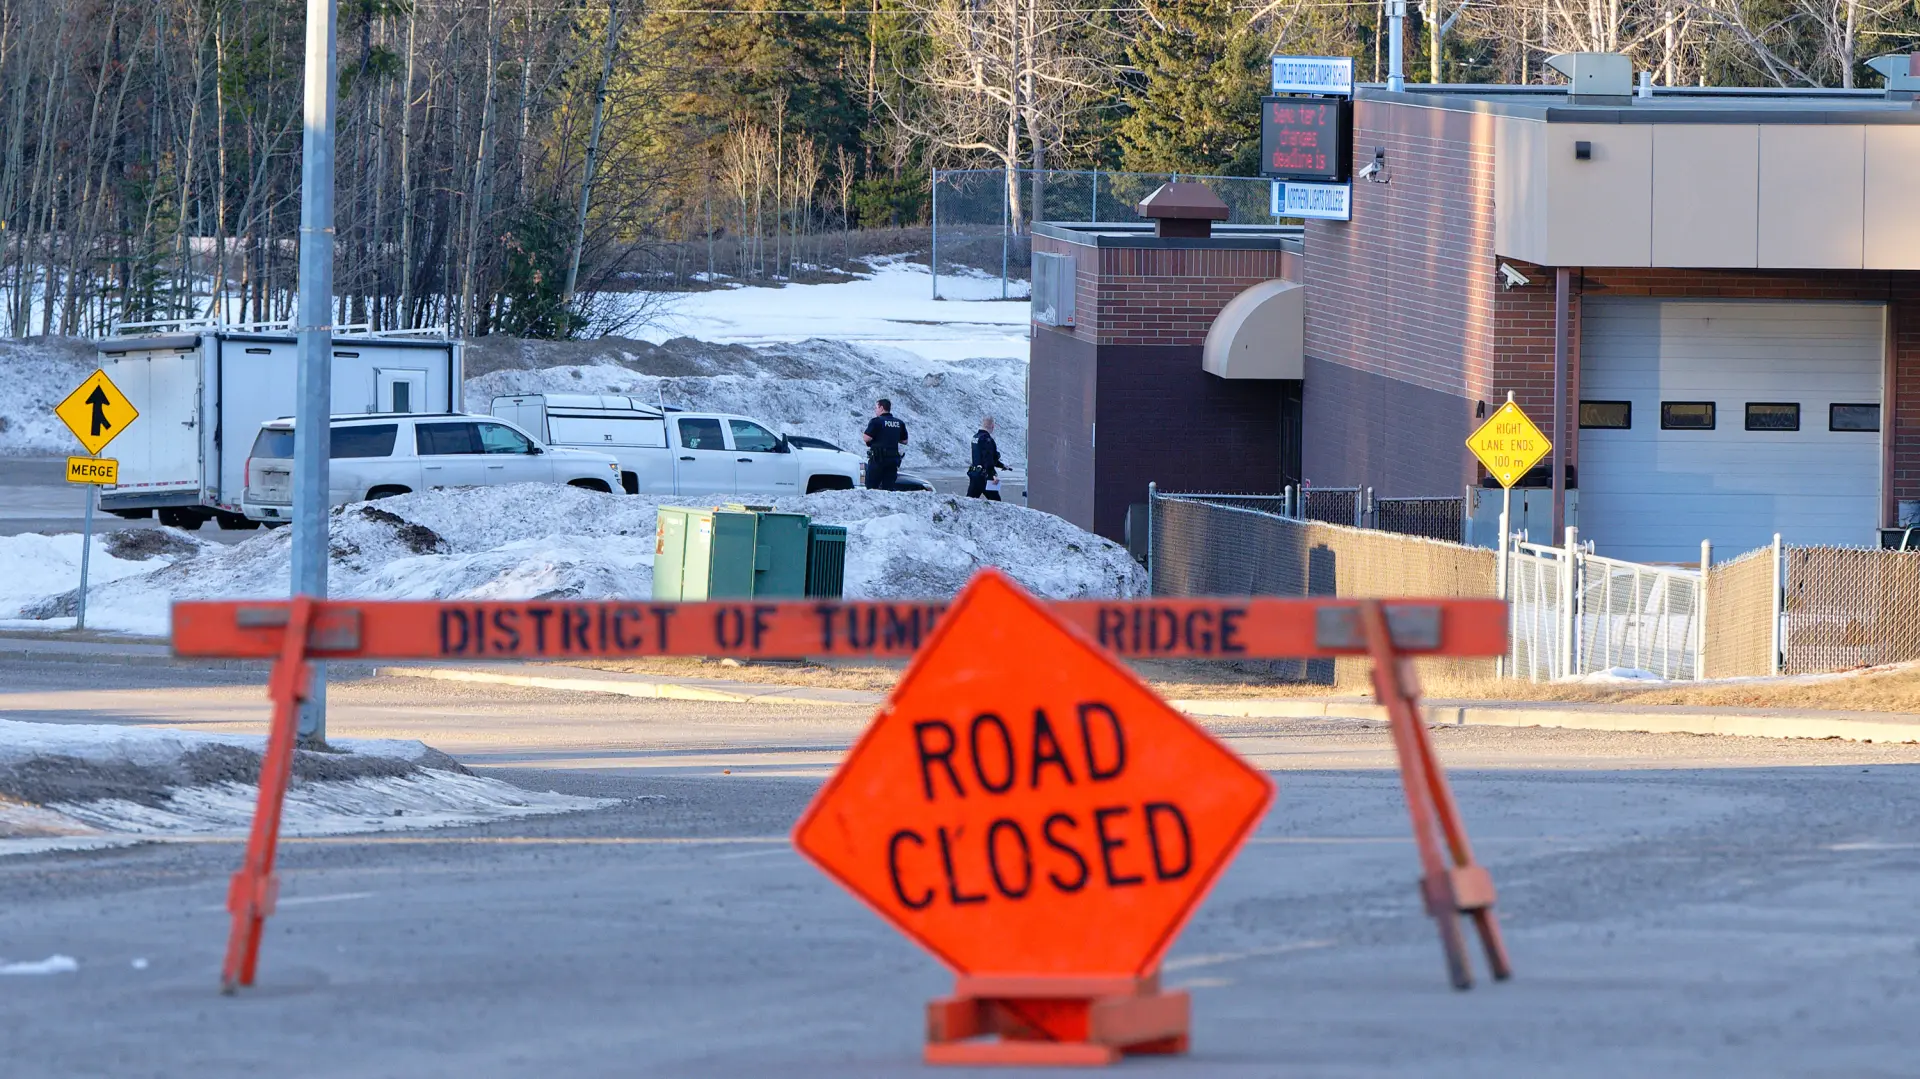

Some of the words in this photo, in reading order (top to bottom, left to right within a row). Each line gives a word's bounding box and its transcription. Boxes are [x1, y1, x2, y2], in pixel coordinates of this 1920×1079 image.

[1318, 104, 1326, 125] 2
[884, 420, 901, 428] POLICE
[1496, 422, 1521, 435] RIGHT
[1481, 439, 1504, 451] LANE
[1511, 439, 1534, 451] ENDS
[1494, 455, 1510, 468] 100
[1513, 459, 1524, 468] m
[71, 464, 114, 478] MERGE
[439, 607, 677, 655] DISTRICT
[713, 607, 778, 652] OF
[1097, 607, 1247, 653] RIDGE
[913, 701, 1127, 802] ROAD
[887, 801, 1194, 911] CLOSED
